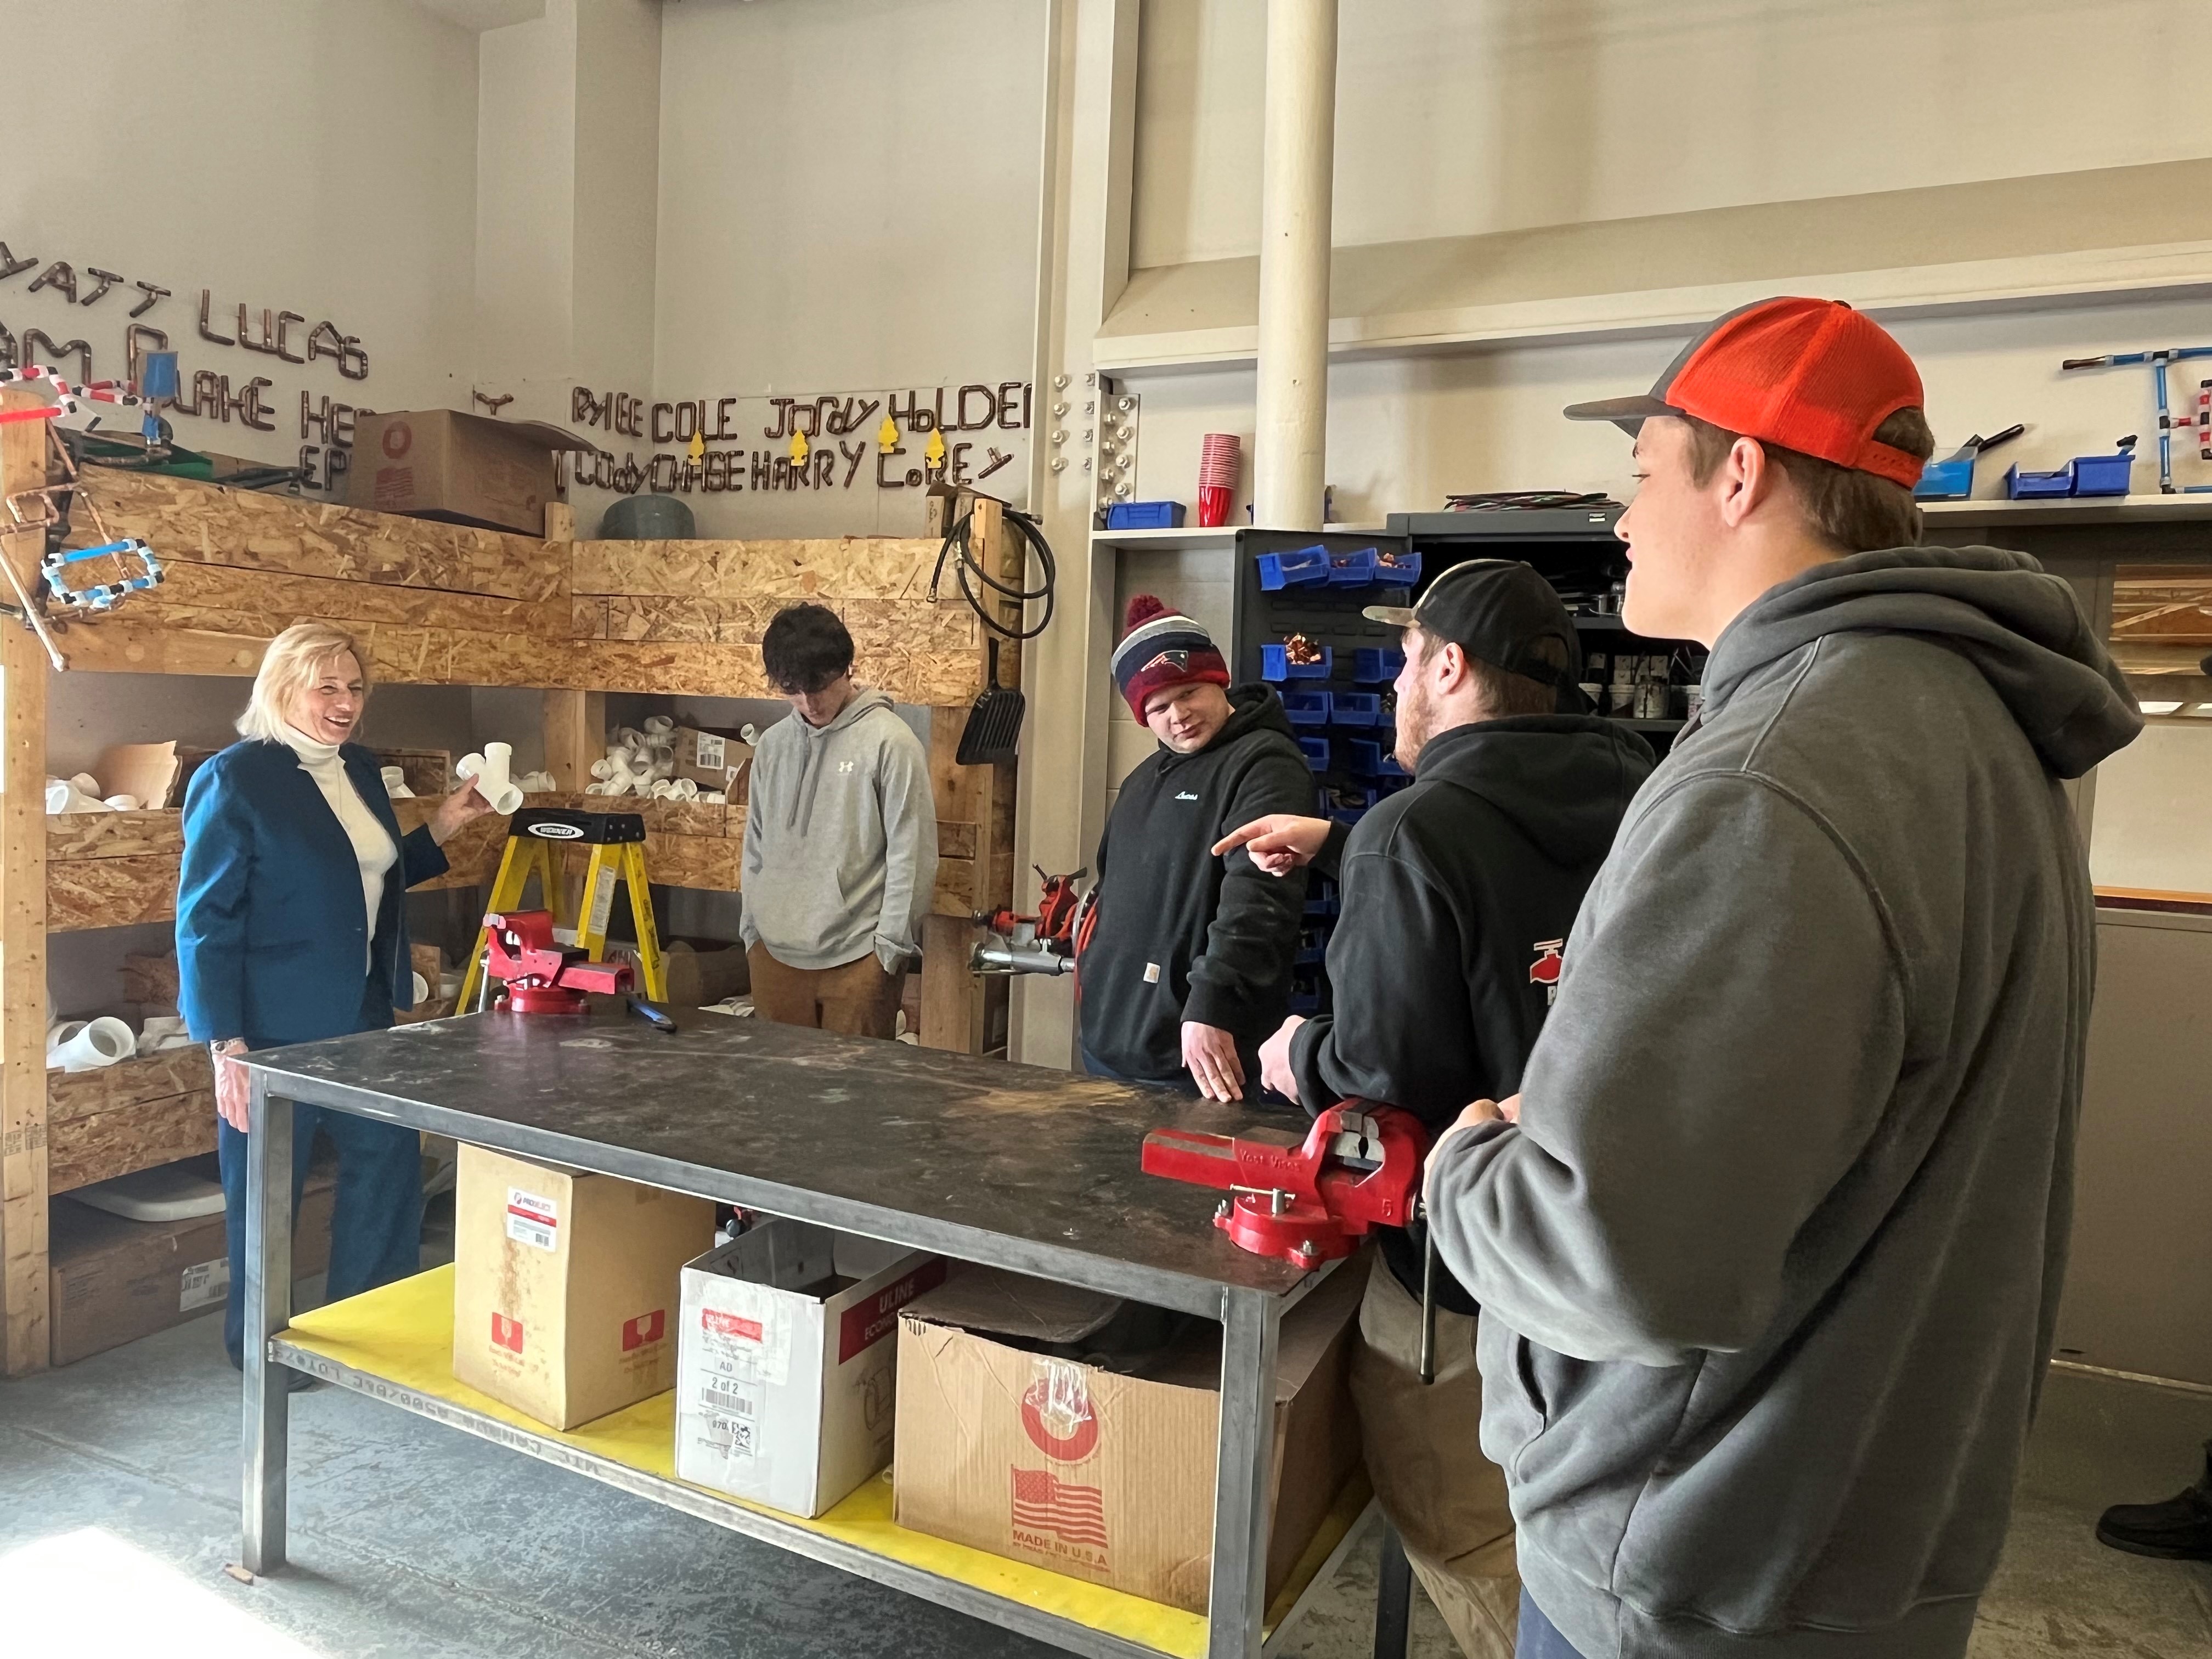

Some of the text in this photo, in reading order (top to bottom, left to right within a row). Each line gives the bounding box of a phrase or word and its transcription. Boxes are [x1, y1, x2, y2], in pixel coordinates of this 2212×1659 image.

[199, 289, 369, 380] LUCAS
[651, 398, 738, 443] COLE
[751, 440, 866, 490] HARRY
[879, 1277, 915, 1313] ULINE
[712, 1376, 739, 1395] 2 of 2
[1013, 1529, 1051, 1549] MADE
[1054, 1541, 1068, 1555] IN
